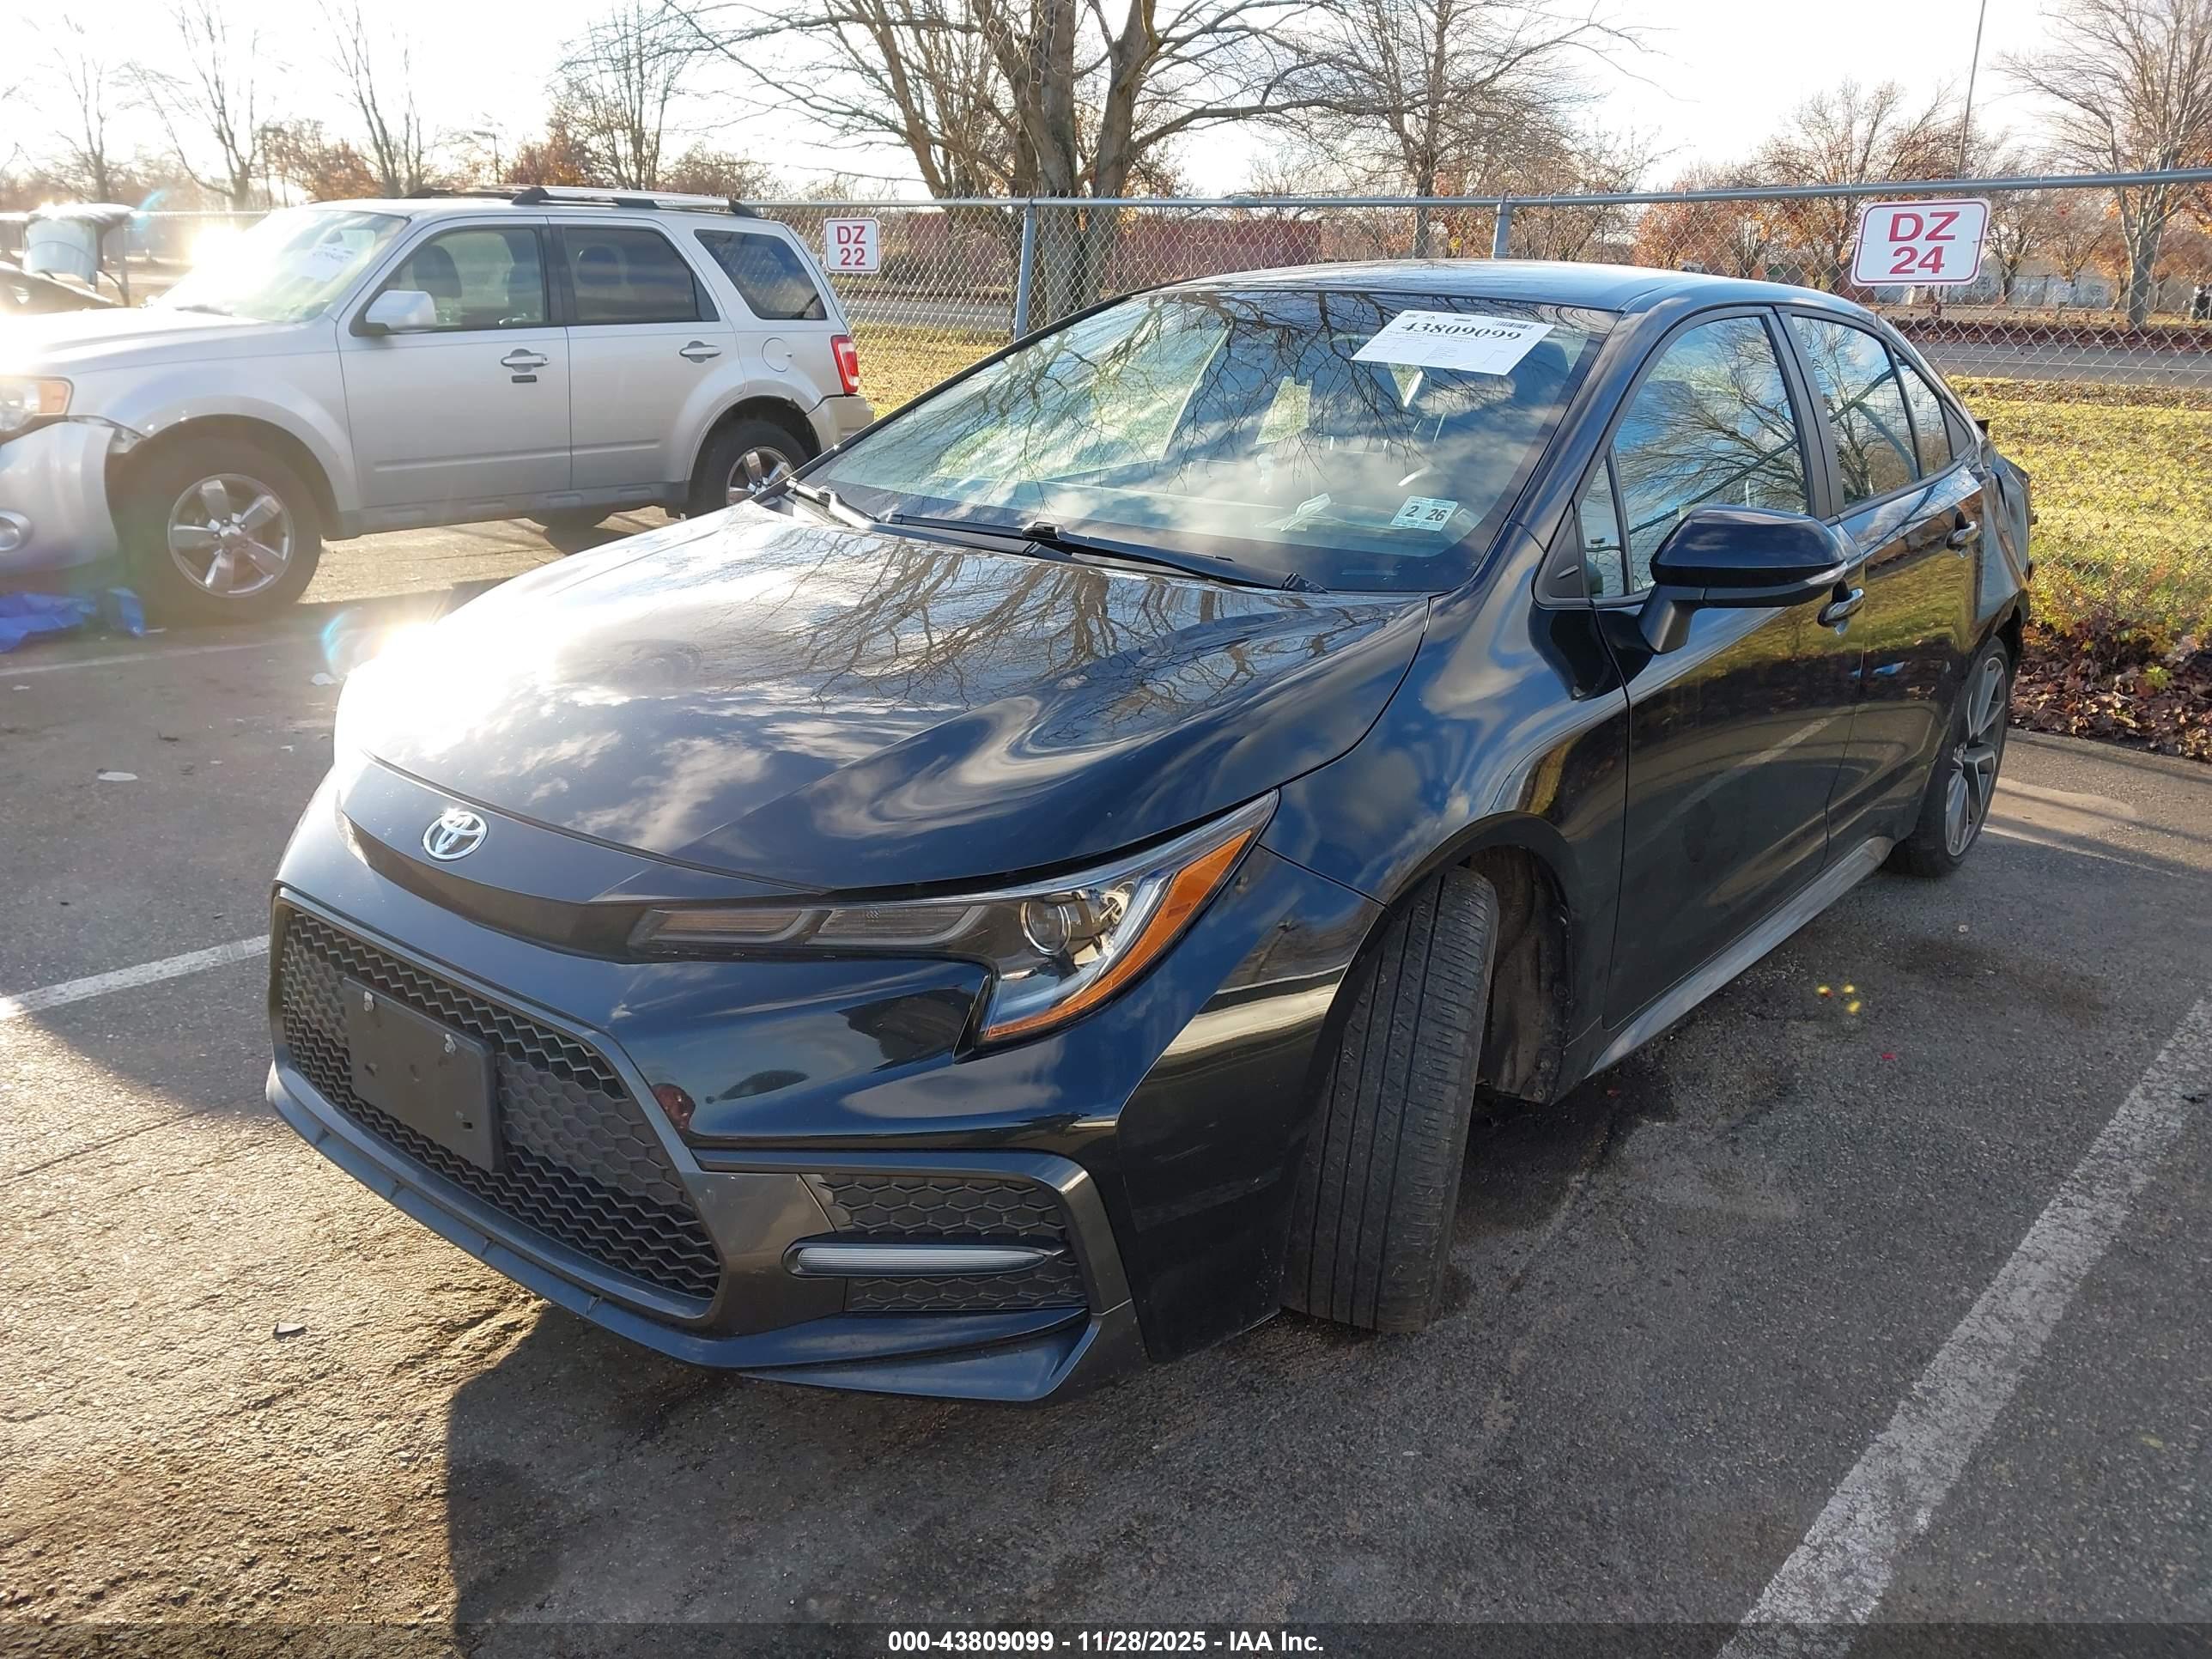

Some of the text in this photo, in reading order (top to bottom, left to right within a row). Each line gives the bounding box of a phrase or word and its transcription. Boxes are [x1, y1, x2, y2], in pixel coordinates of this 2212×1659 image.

[836, 225, 866, 245] DZ
[1888, 211, 1960, 242] DZ
[840, 247, 866, 266] 22
[1888, 246, 1945, 274] 24
[1401, 321, 1522, 341] 43809099
[1405, 505, 1419, 517] 2
[1425, 508, 1447, 521] 26
